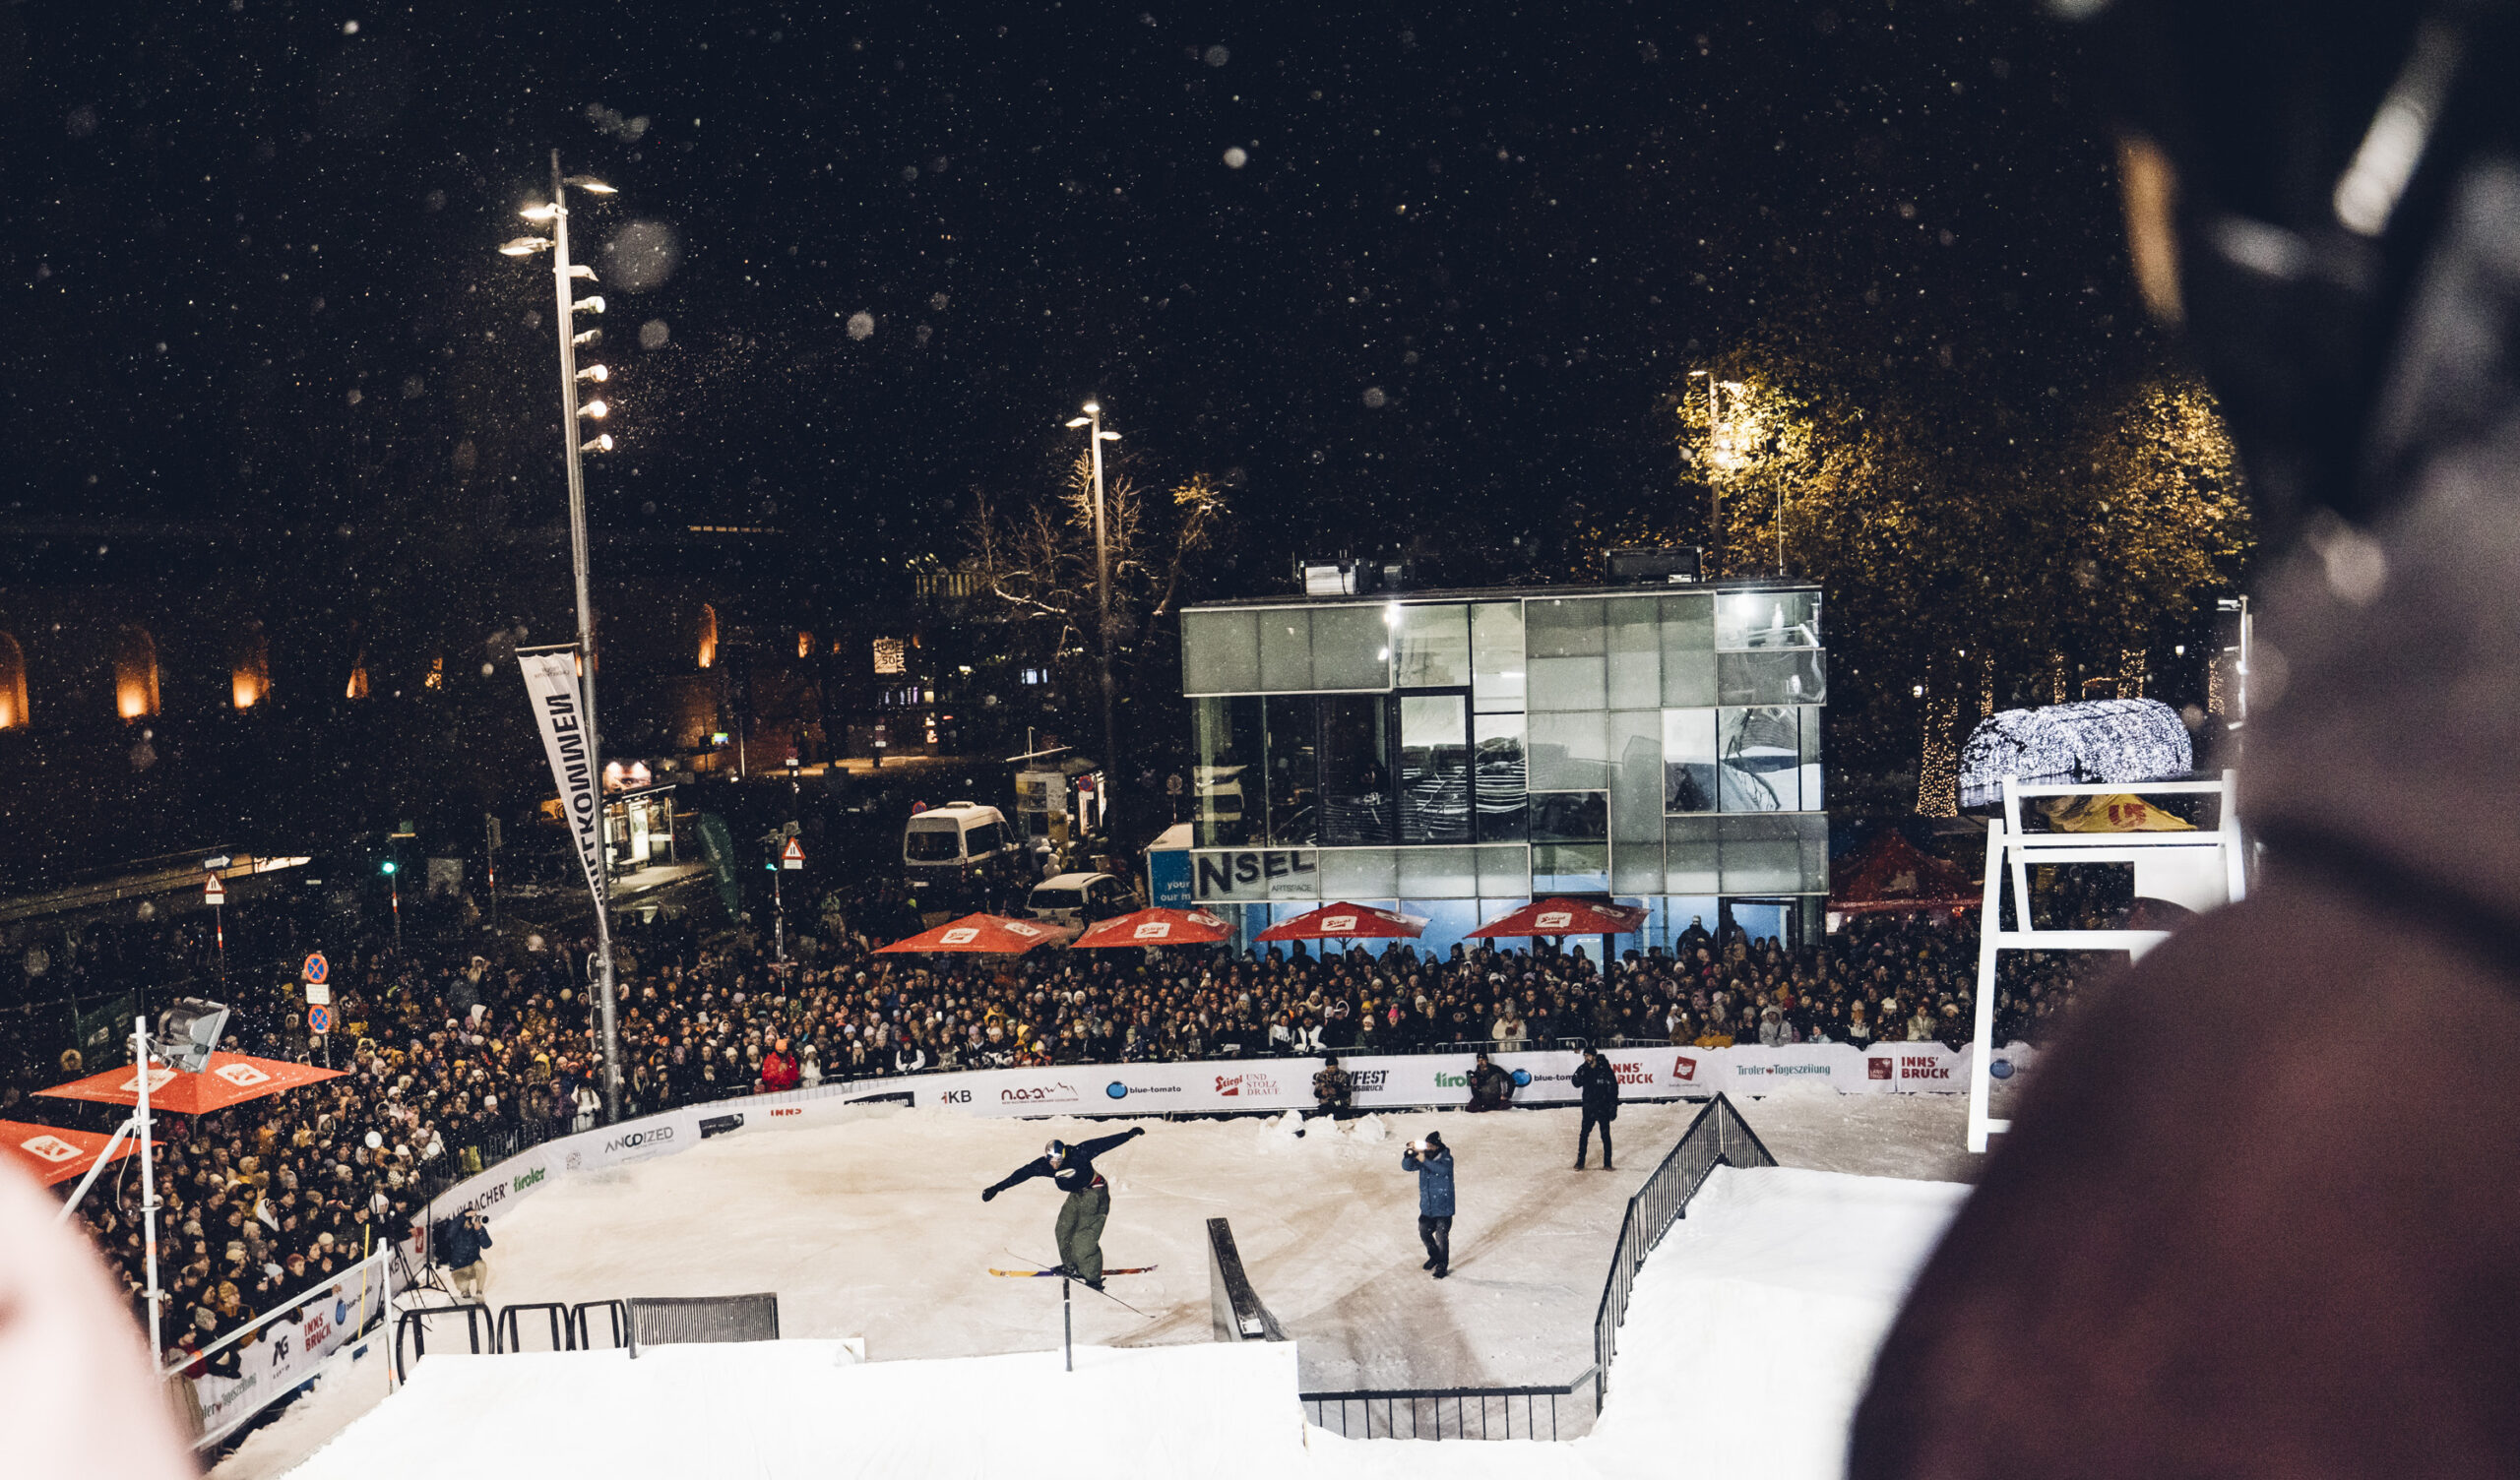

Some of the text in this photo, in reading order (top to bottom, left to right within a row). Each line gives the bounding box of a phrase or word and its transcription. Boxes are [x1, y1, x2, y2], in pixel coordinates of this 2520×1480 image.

[1167, 881, 1190, 891] your
[1736, 1064, 1831, 1076] Tiroler Tageszeitung
[1901, 1068, 1950, 1079] BRUCK
[1216, 1075, 1242, 1092] Stiegl
[941, 1089, 972, 1104] iKB
[514, 1167, 545, 1193] tiroler
[305, 1322, 332, 1352] BRUCK
